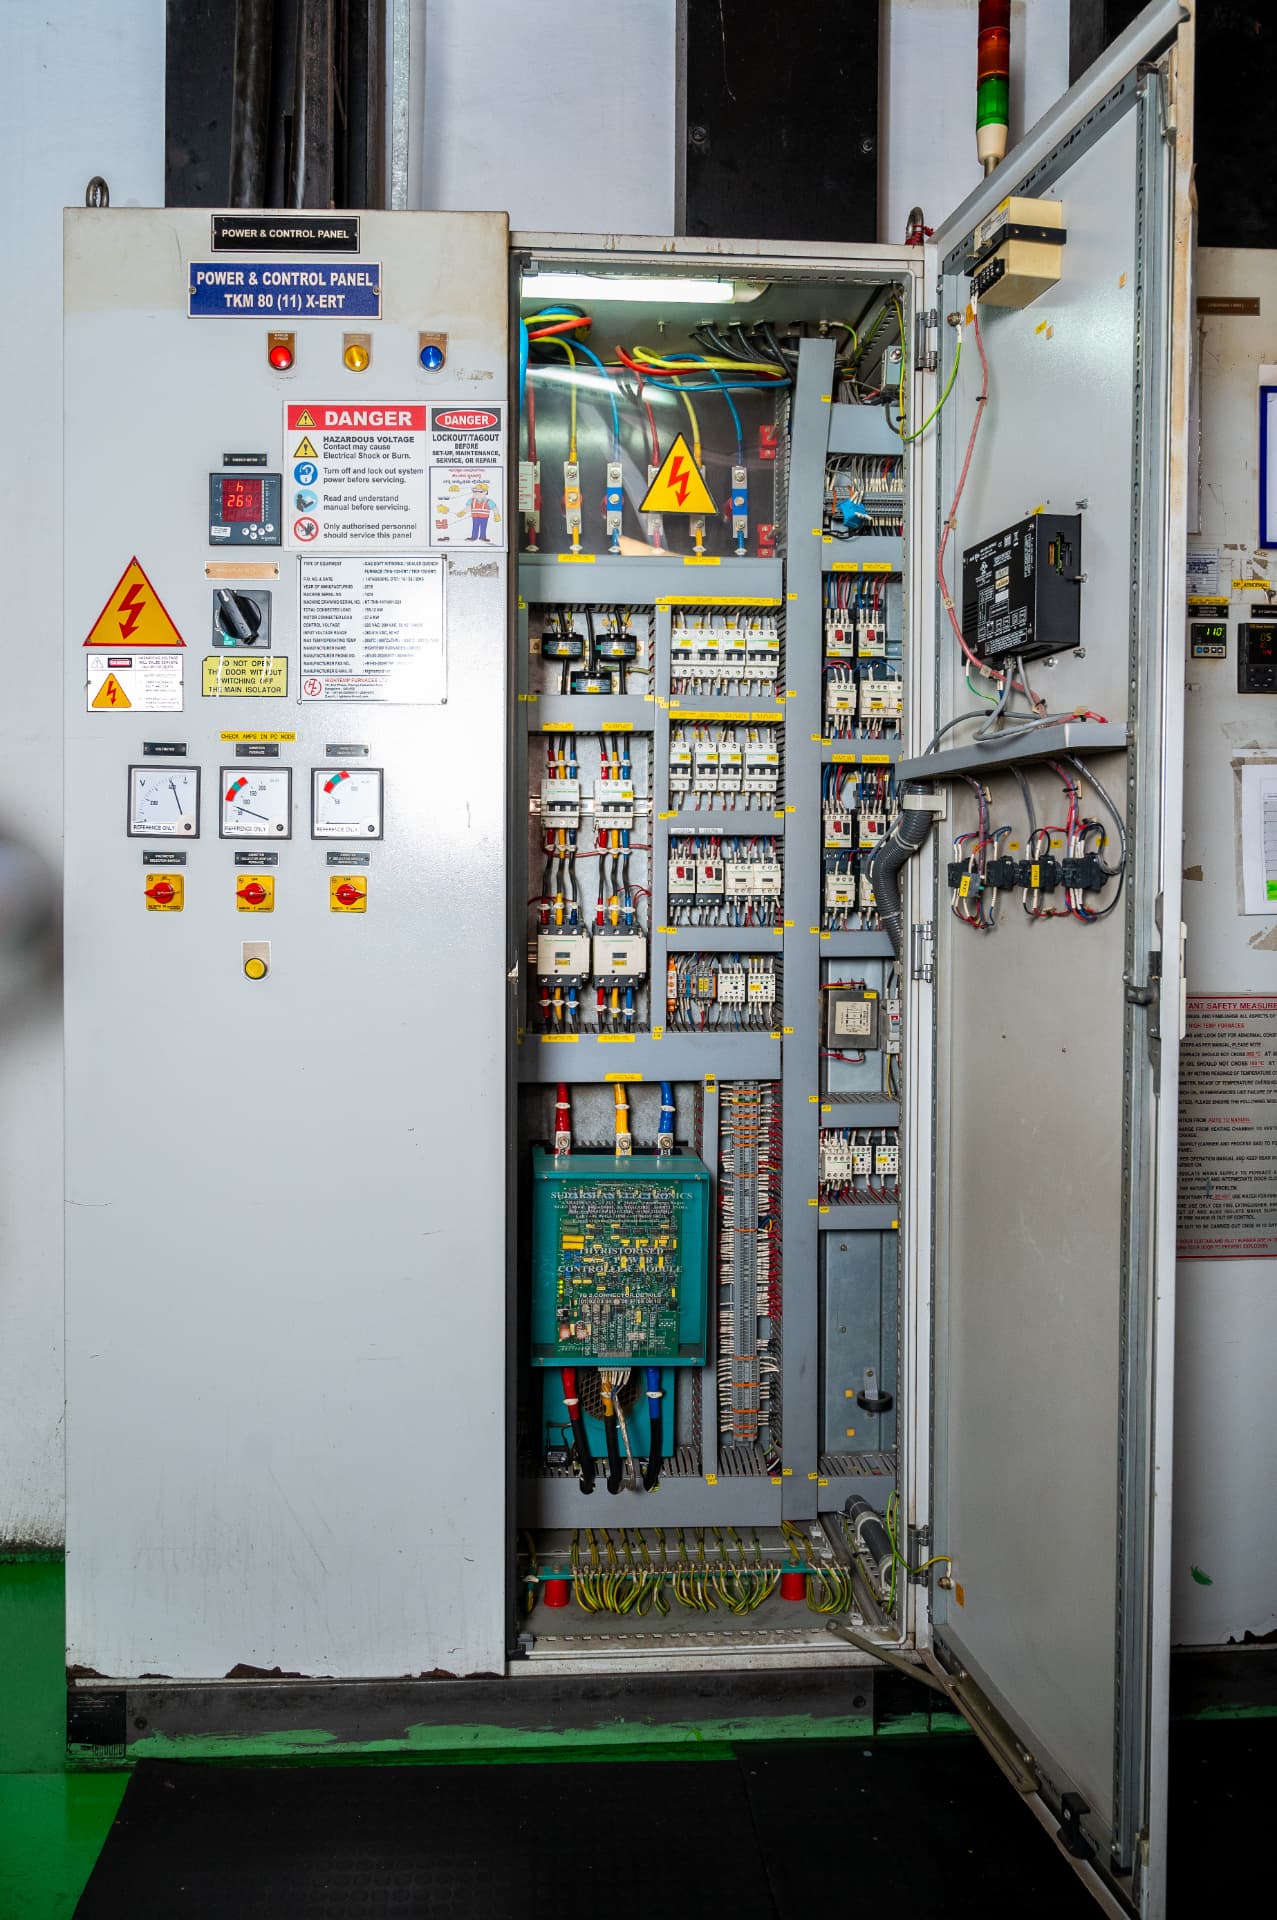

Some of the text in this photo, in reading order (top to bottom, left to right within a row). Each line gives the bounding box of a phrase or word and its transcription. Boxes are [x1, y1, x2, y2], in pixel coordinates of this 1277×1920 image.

[222, 229, 349, 239] POWER & CONTROL PANEL
[196, 271, 373, 286] POWER & CONTROL PANEL
[224, 294, 345, 311] TKM 80 (11) X-ERT
[324, 411, 413, 426] DANGER
[444, 415, 489, 425] DANGER
[432, 434, 499, 442] LOCKOUT/TAGOUT
[398, 468, 424, 476] system
[370, 476, 407, 485] servicing.
[375, 504, 411, 512] servicing.
[323, 523, 340, 531] Only
[381, 523, 417, 531] personnel
[392, 532, 412, 540] panel
[1206, 627, 1223, 636] 110
[225, 668, 246, 676] DOOR
[139, 779, 146, 787] V
[1206, 1002, 1238, 1010] SAFETY
